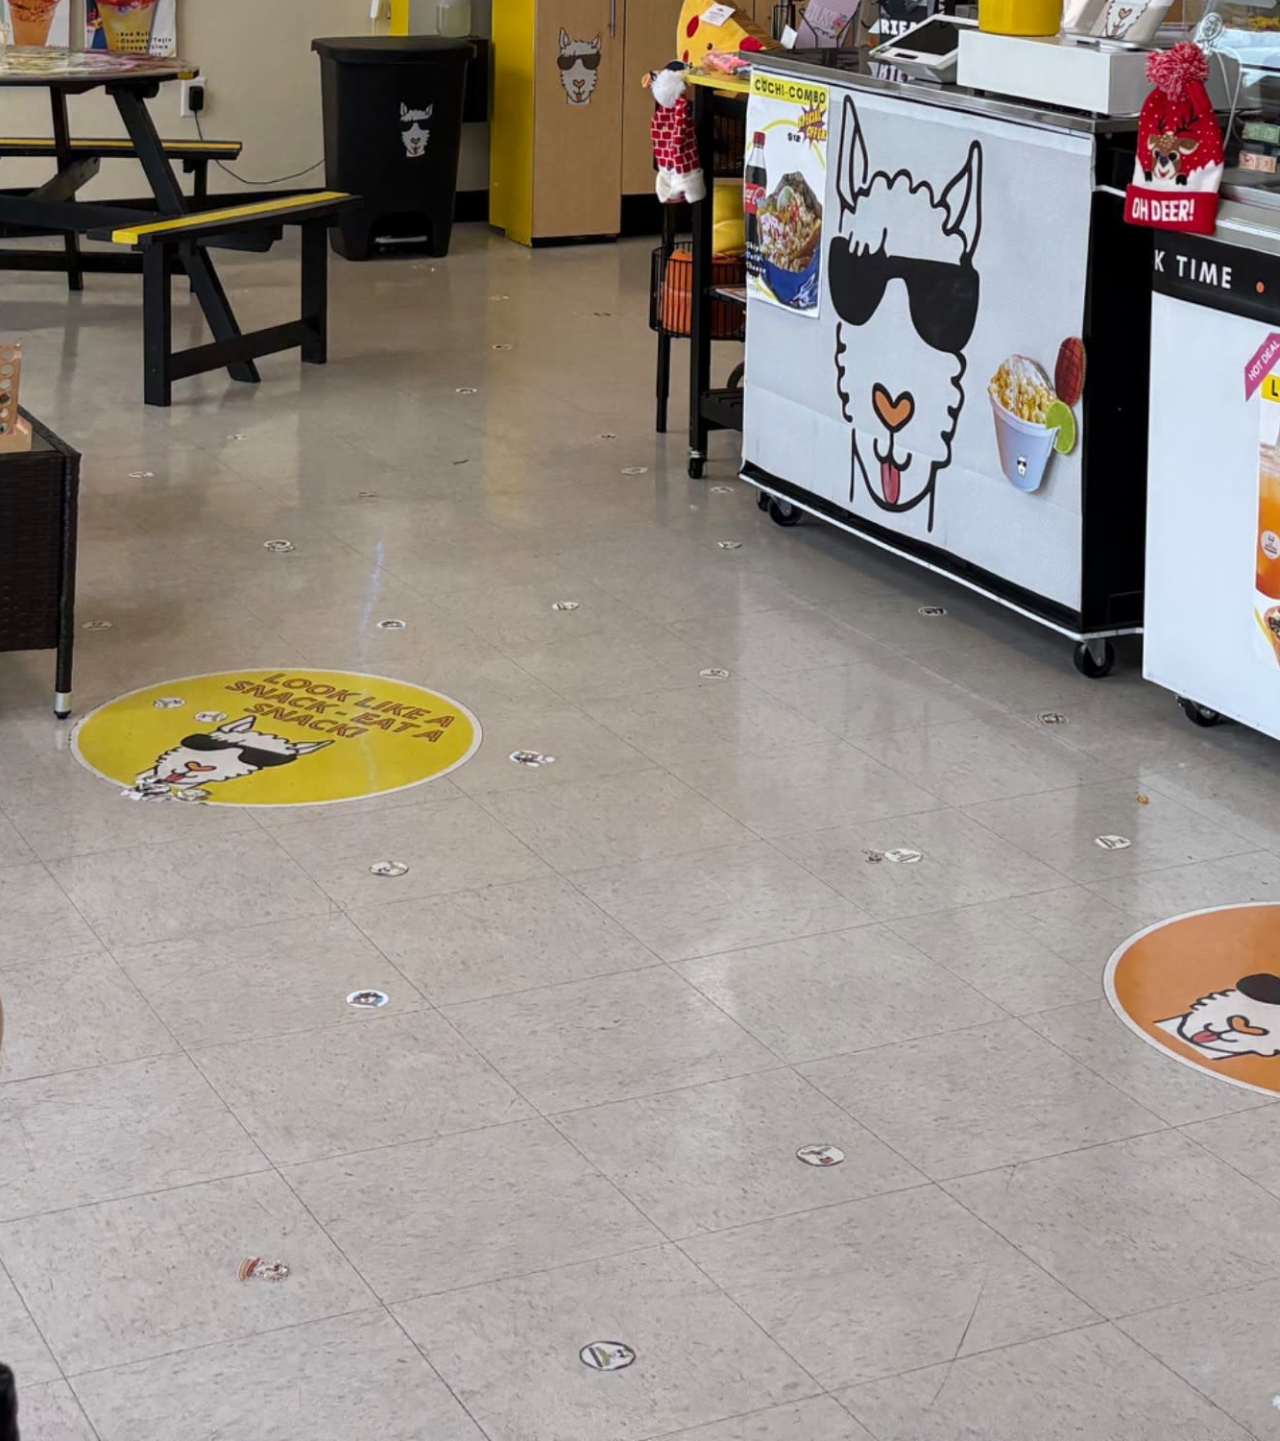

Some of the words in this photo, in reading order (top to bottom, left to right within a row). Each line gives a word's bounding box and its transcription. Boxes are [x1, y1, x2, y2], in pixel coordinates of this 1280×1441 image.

[1130, 198, 1159, 221] OH
[1160, 198, 1195, 222] DEER!
[1175, 253, 1233, 290] TIME
[1246, 357, 1265, 382] HOT
[1258, 339, 1280, 365] DEAL
[224, 679, 327, 716] SNACK
[355, 711, 411, 735] EAT
[419, 726, 445, 742] A
[262, 672, 359, 704] LOOK
[355, 694, 433, 720] LIKE
[433, 712, 457, 729] A
